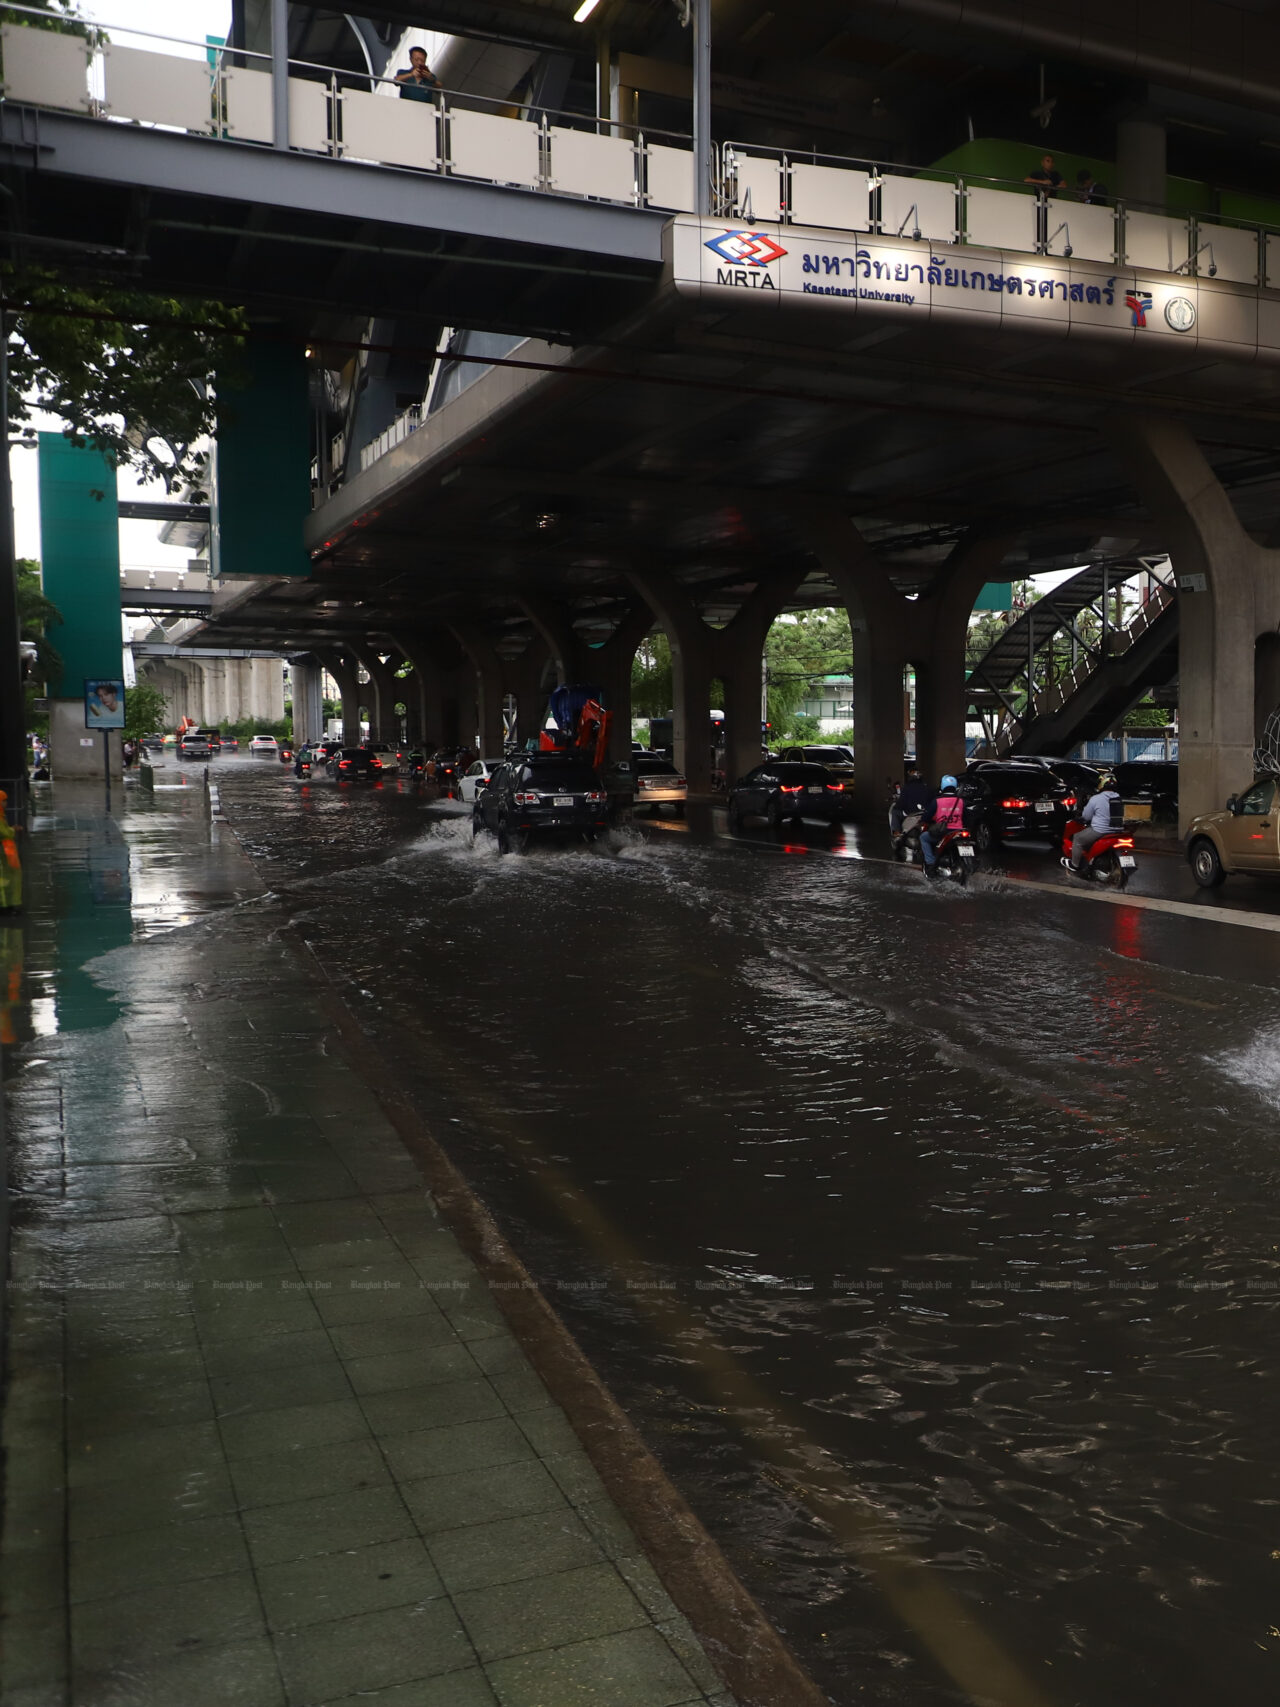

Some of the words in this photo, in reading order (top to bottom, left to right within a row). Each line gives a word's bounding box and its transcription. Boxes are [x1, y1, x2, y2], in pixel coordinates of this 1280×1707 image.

[717, 267, 775, 290] MRTA
[802, 249, 1116, 305] มหาวิทยาลัยเกษตรศาสตร์
[860, 288, 915, 305] University
